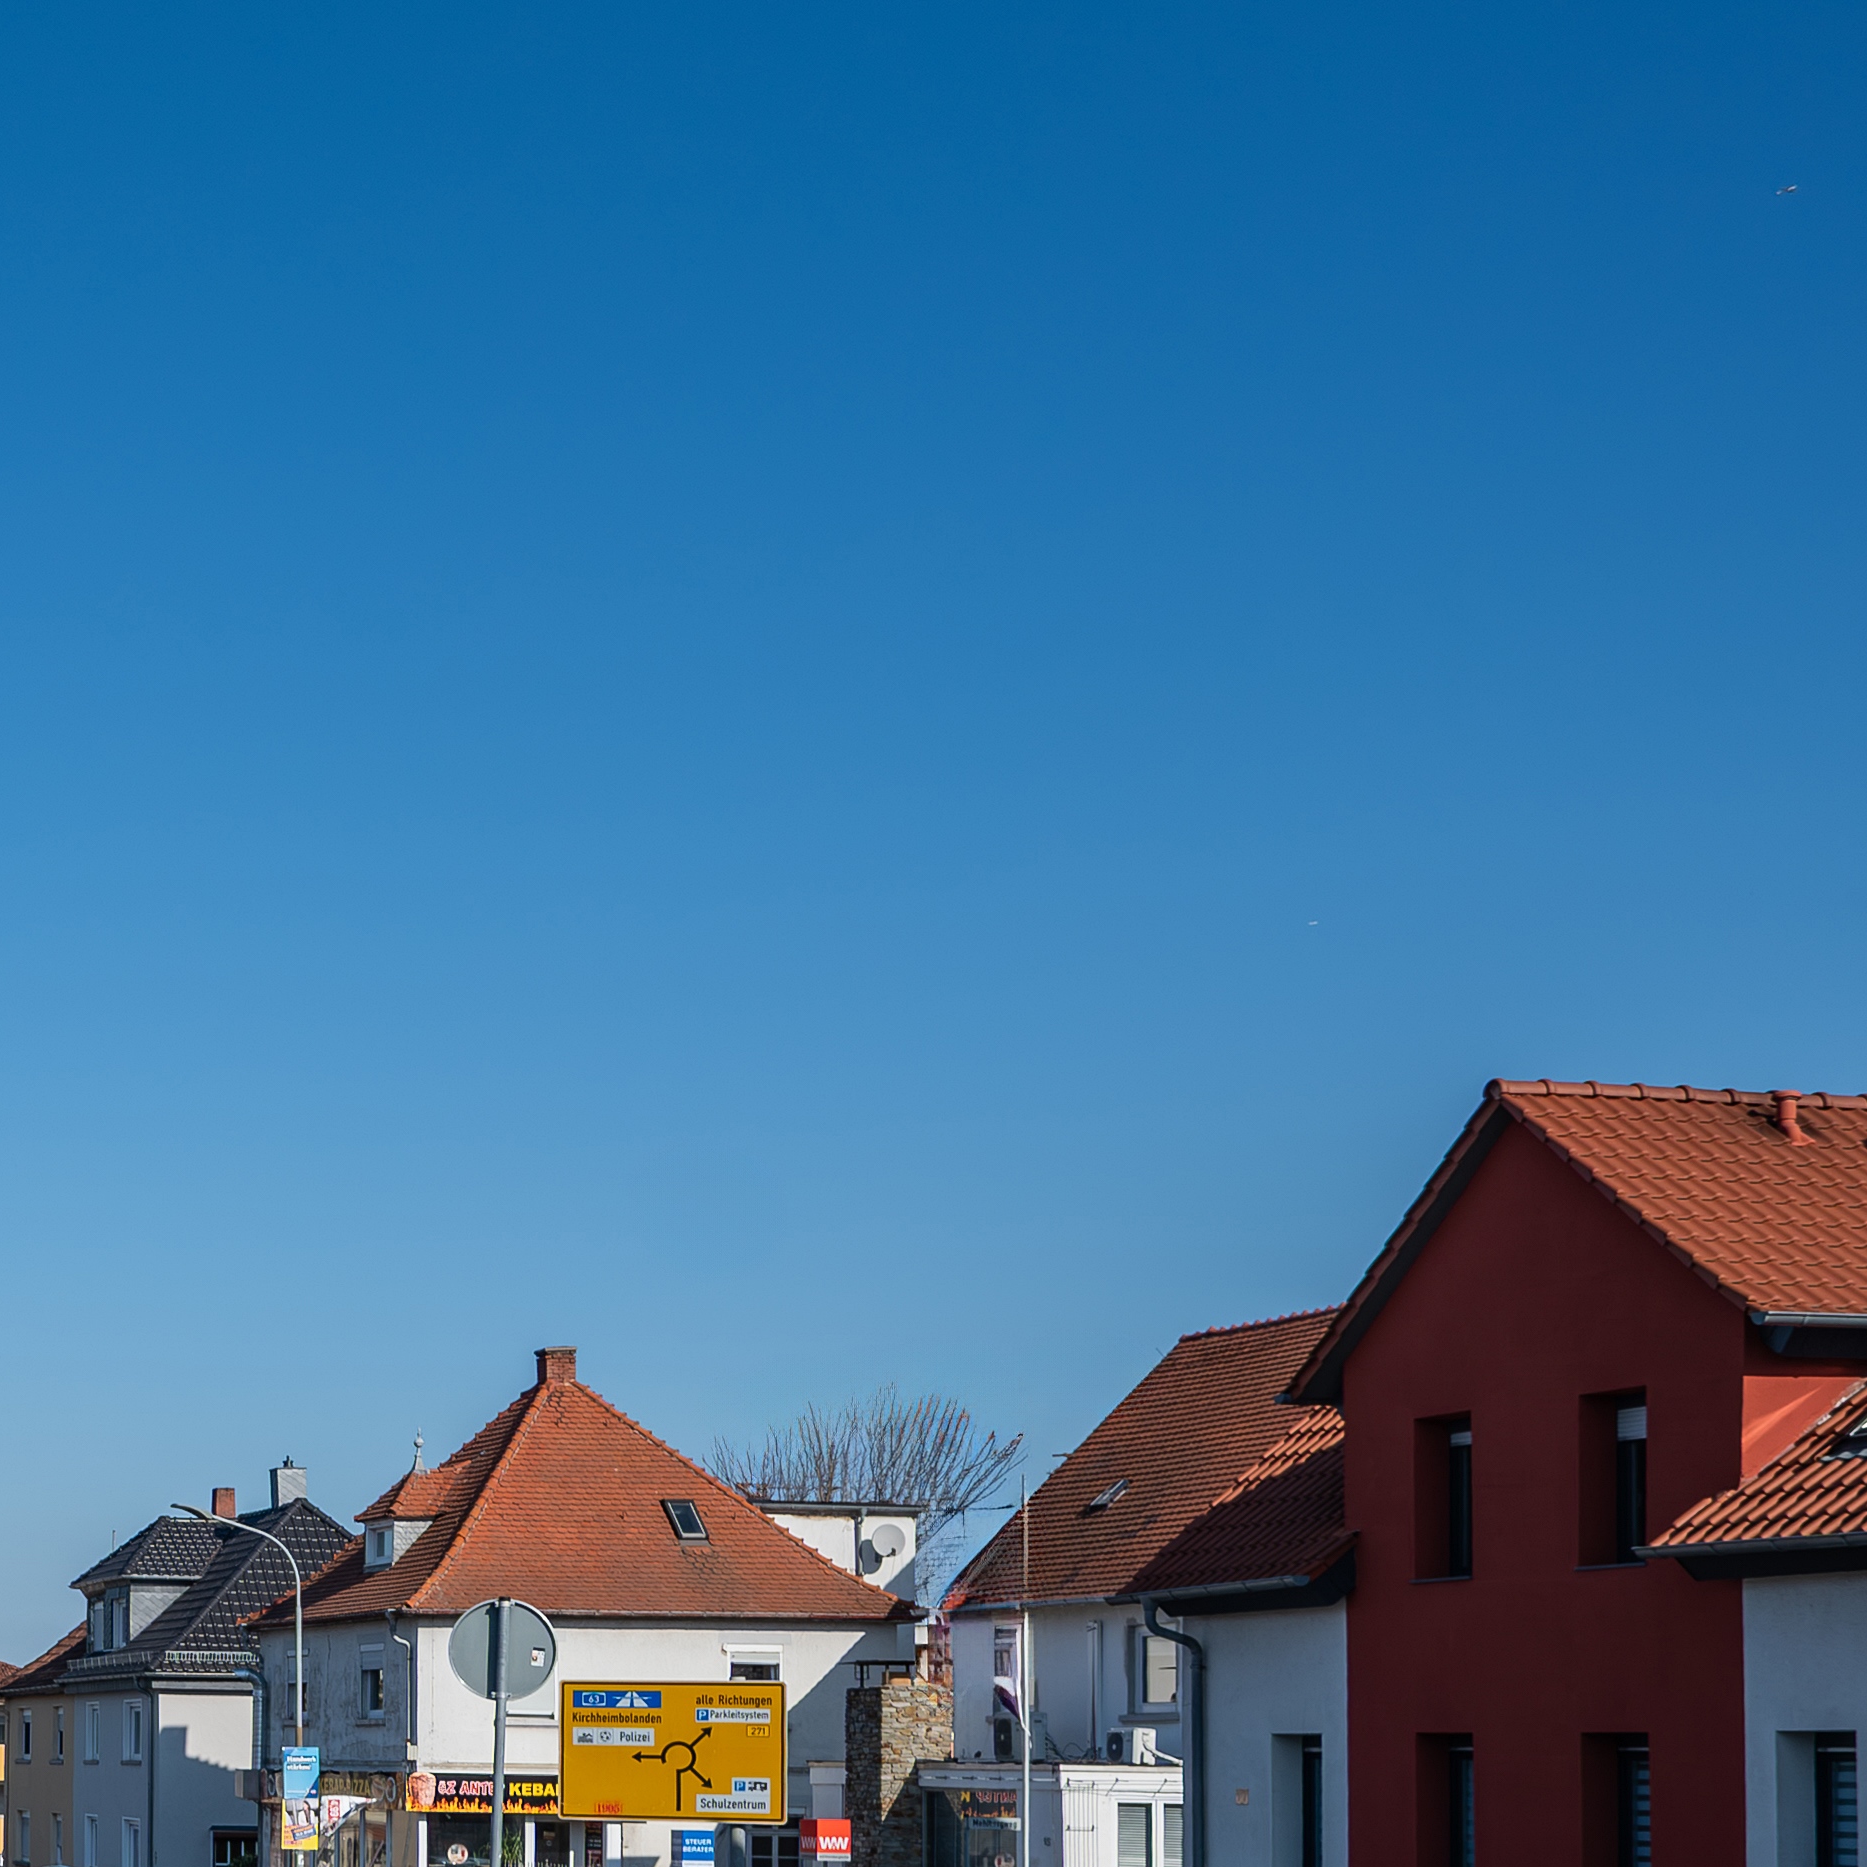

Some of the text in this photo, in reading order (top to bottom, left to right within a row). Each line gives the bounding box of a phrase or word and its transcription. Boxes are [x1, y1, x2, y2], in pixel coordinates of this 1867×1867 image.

[588, 1694, 600, 1704] 63
[695, 1694, 773, 1708] alle Richtungen
[572, 1712, 662, 1724] Kirchheimbolanden
[709, 1710, 769, 1721] Parkleitsystem
[619, 1731, 651, 1743] Polizei
[751, 1727, 766, 1736] 271
[459, 1780, 495, 1796] ANTE
[509, 1783, 559, 1797] KEBA
[700, 1797, 767, 1810] Schulzentrum
[685, 1838, 712, 1846] STEUER
